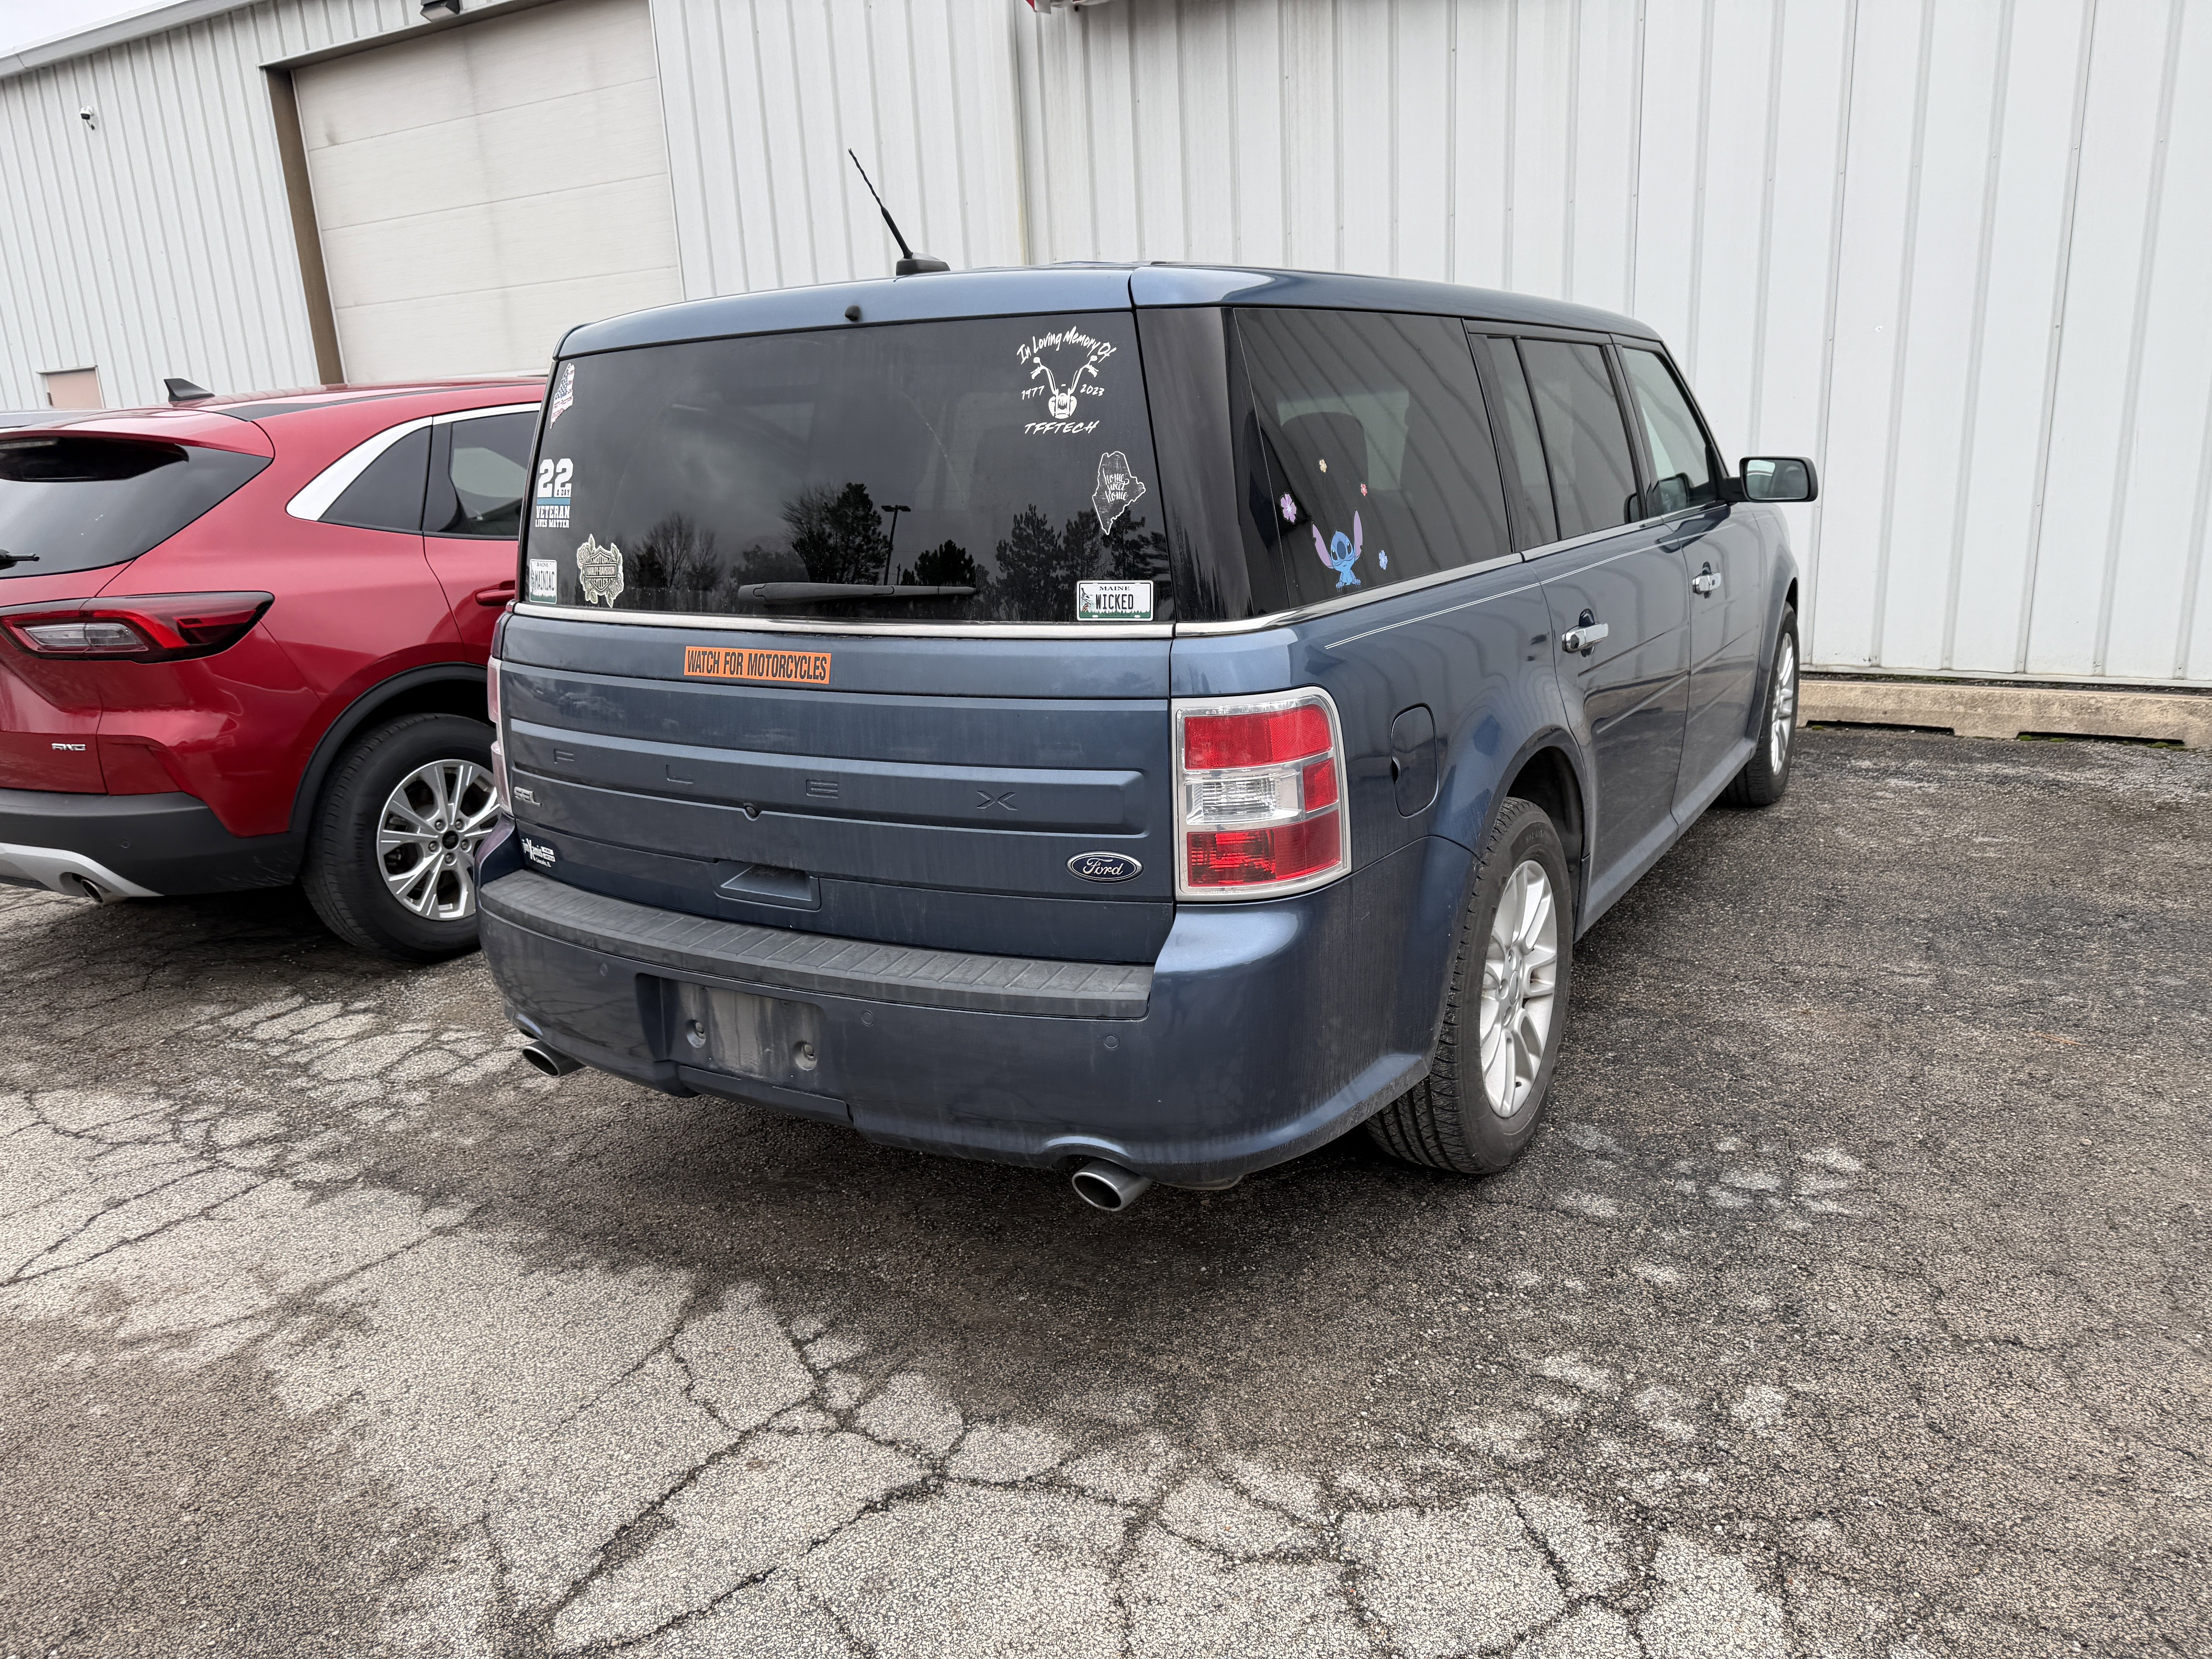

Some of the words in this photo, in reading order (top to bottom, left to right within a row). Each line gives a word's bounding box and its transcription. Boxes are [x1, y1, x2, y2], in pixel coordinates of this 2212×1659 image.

[1017, 344, 1032, 365] In
[1032, 332, 1062, 354] Loving
[1063, 326, 1101, 357] Memory
[1097, 342, 1117, 363] Of
[1021, 385, 1045, 400] 1977
[1080, 384, 1105, 397] 2023
[1025, 420, 1100, 434] TFFTECH
[537, 458, 574, 498] 22
[1103, 468, 1125, 485] home
[1105, 490, 1128, 503] home
[536, 505, 570, 519] VETERAN
[535, 519, 548, 527] LIVES
[549, 519, 569, 528] MATTER
[535, 570, 555, 591] MAINIAC
[1096, 594, 1133, 610] WICKED
[688, 650, 721, 674] WATCH
[723, 652, 744, 675] FOR
[747, 653, 827, 681] MOTORCYCLES
[554, 748, 1018, 811] FLEX
[514, 787, 541, 807] SEL
[1083, 858, 1124, 875] Ford
